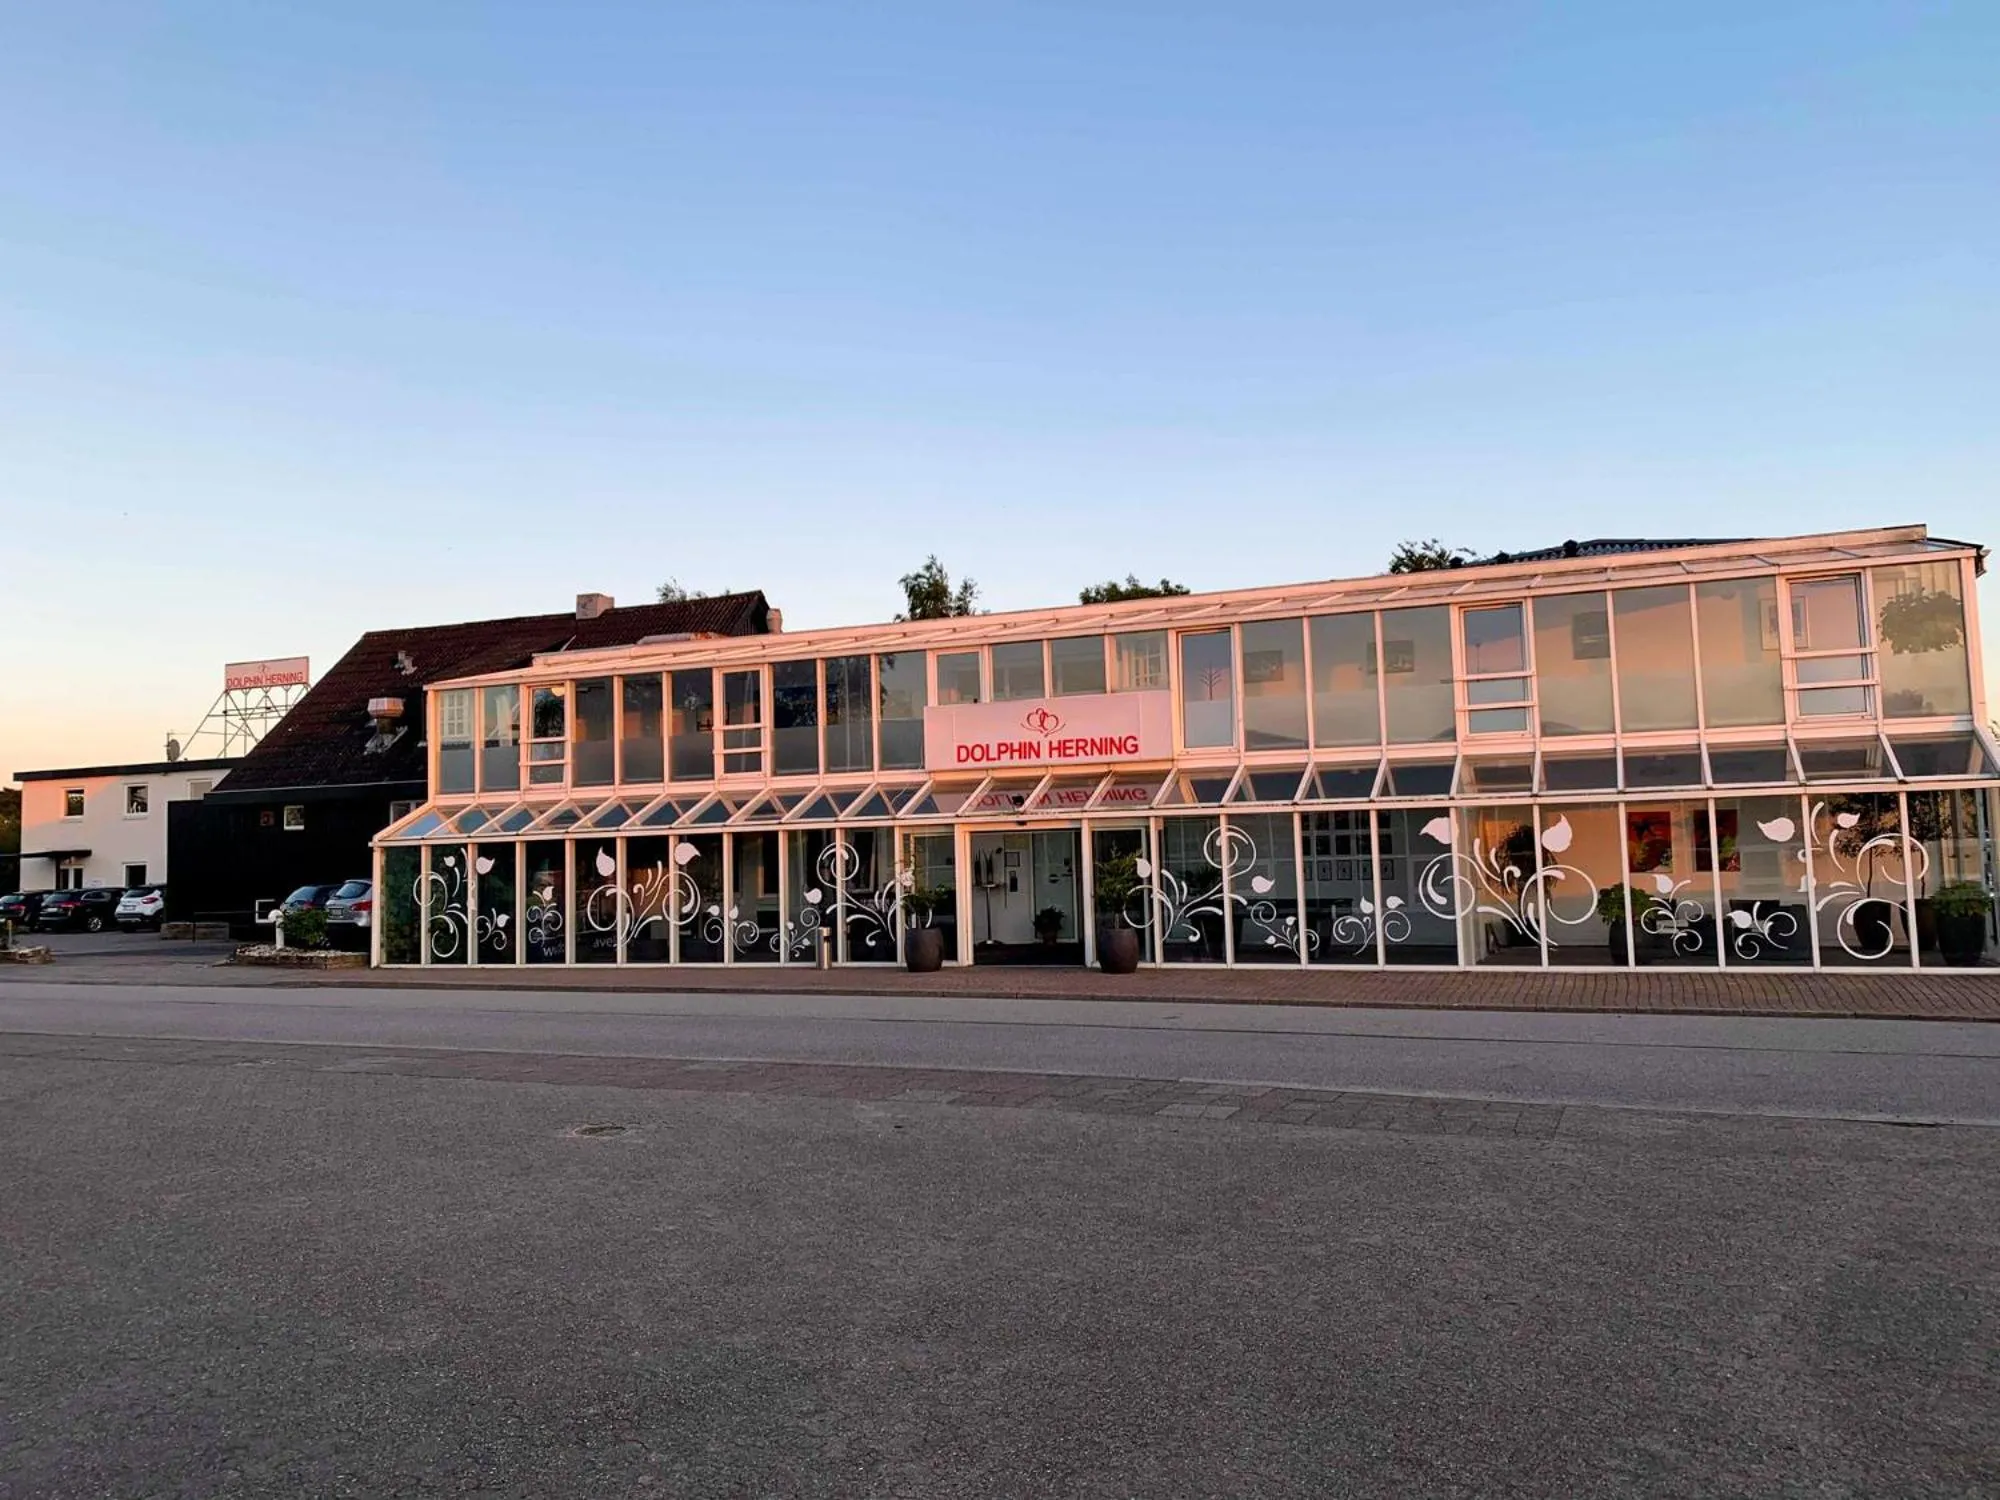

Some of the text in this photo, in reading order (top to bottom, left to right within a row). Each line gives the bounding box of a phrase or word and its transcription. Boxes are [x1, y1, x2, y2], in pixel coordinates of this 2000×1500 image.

[227, 672, 304, 687] DOLPHIN HERNING
[957, 735, 1139, 763] DOLPHIN HERNING
